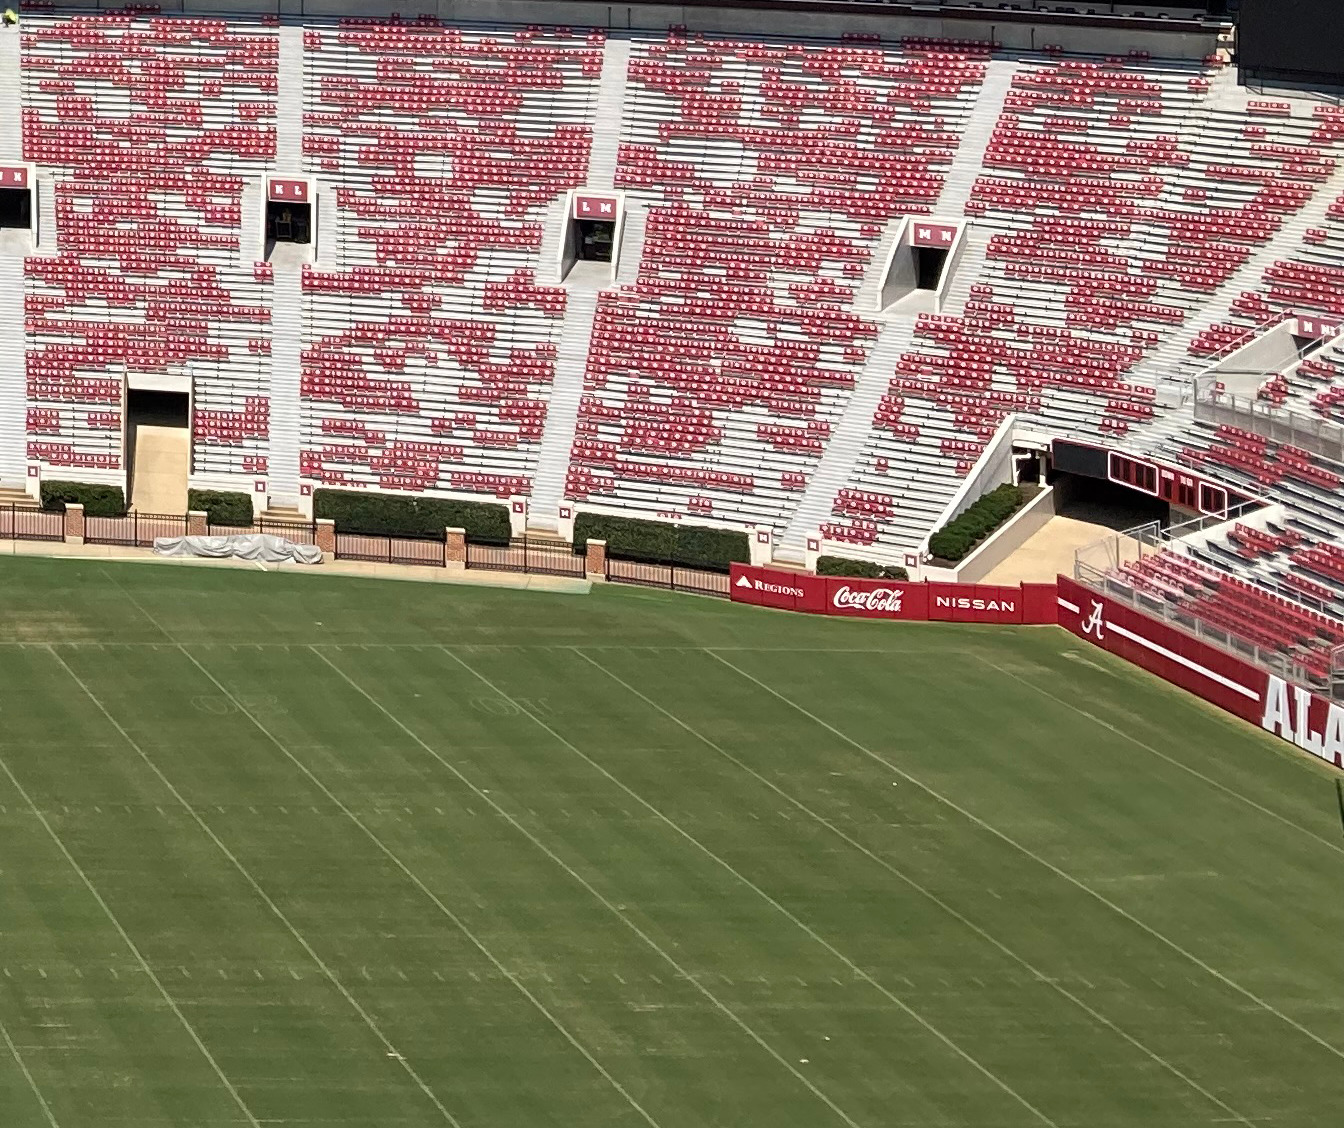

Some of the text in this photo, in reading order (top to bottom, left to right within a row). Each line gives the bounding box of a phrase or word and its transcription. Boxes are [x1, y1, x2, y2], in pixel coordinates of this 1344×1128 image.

[295, 186, 302, 195] L
[583, 202, 611, 212] L M
[919, 229, 951, 241] M N
[1304, 321, 1312, 332] N
[754, 579, 804, 598] REGIONS
[936, 596, 1015, 612] NISSAN
